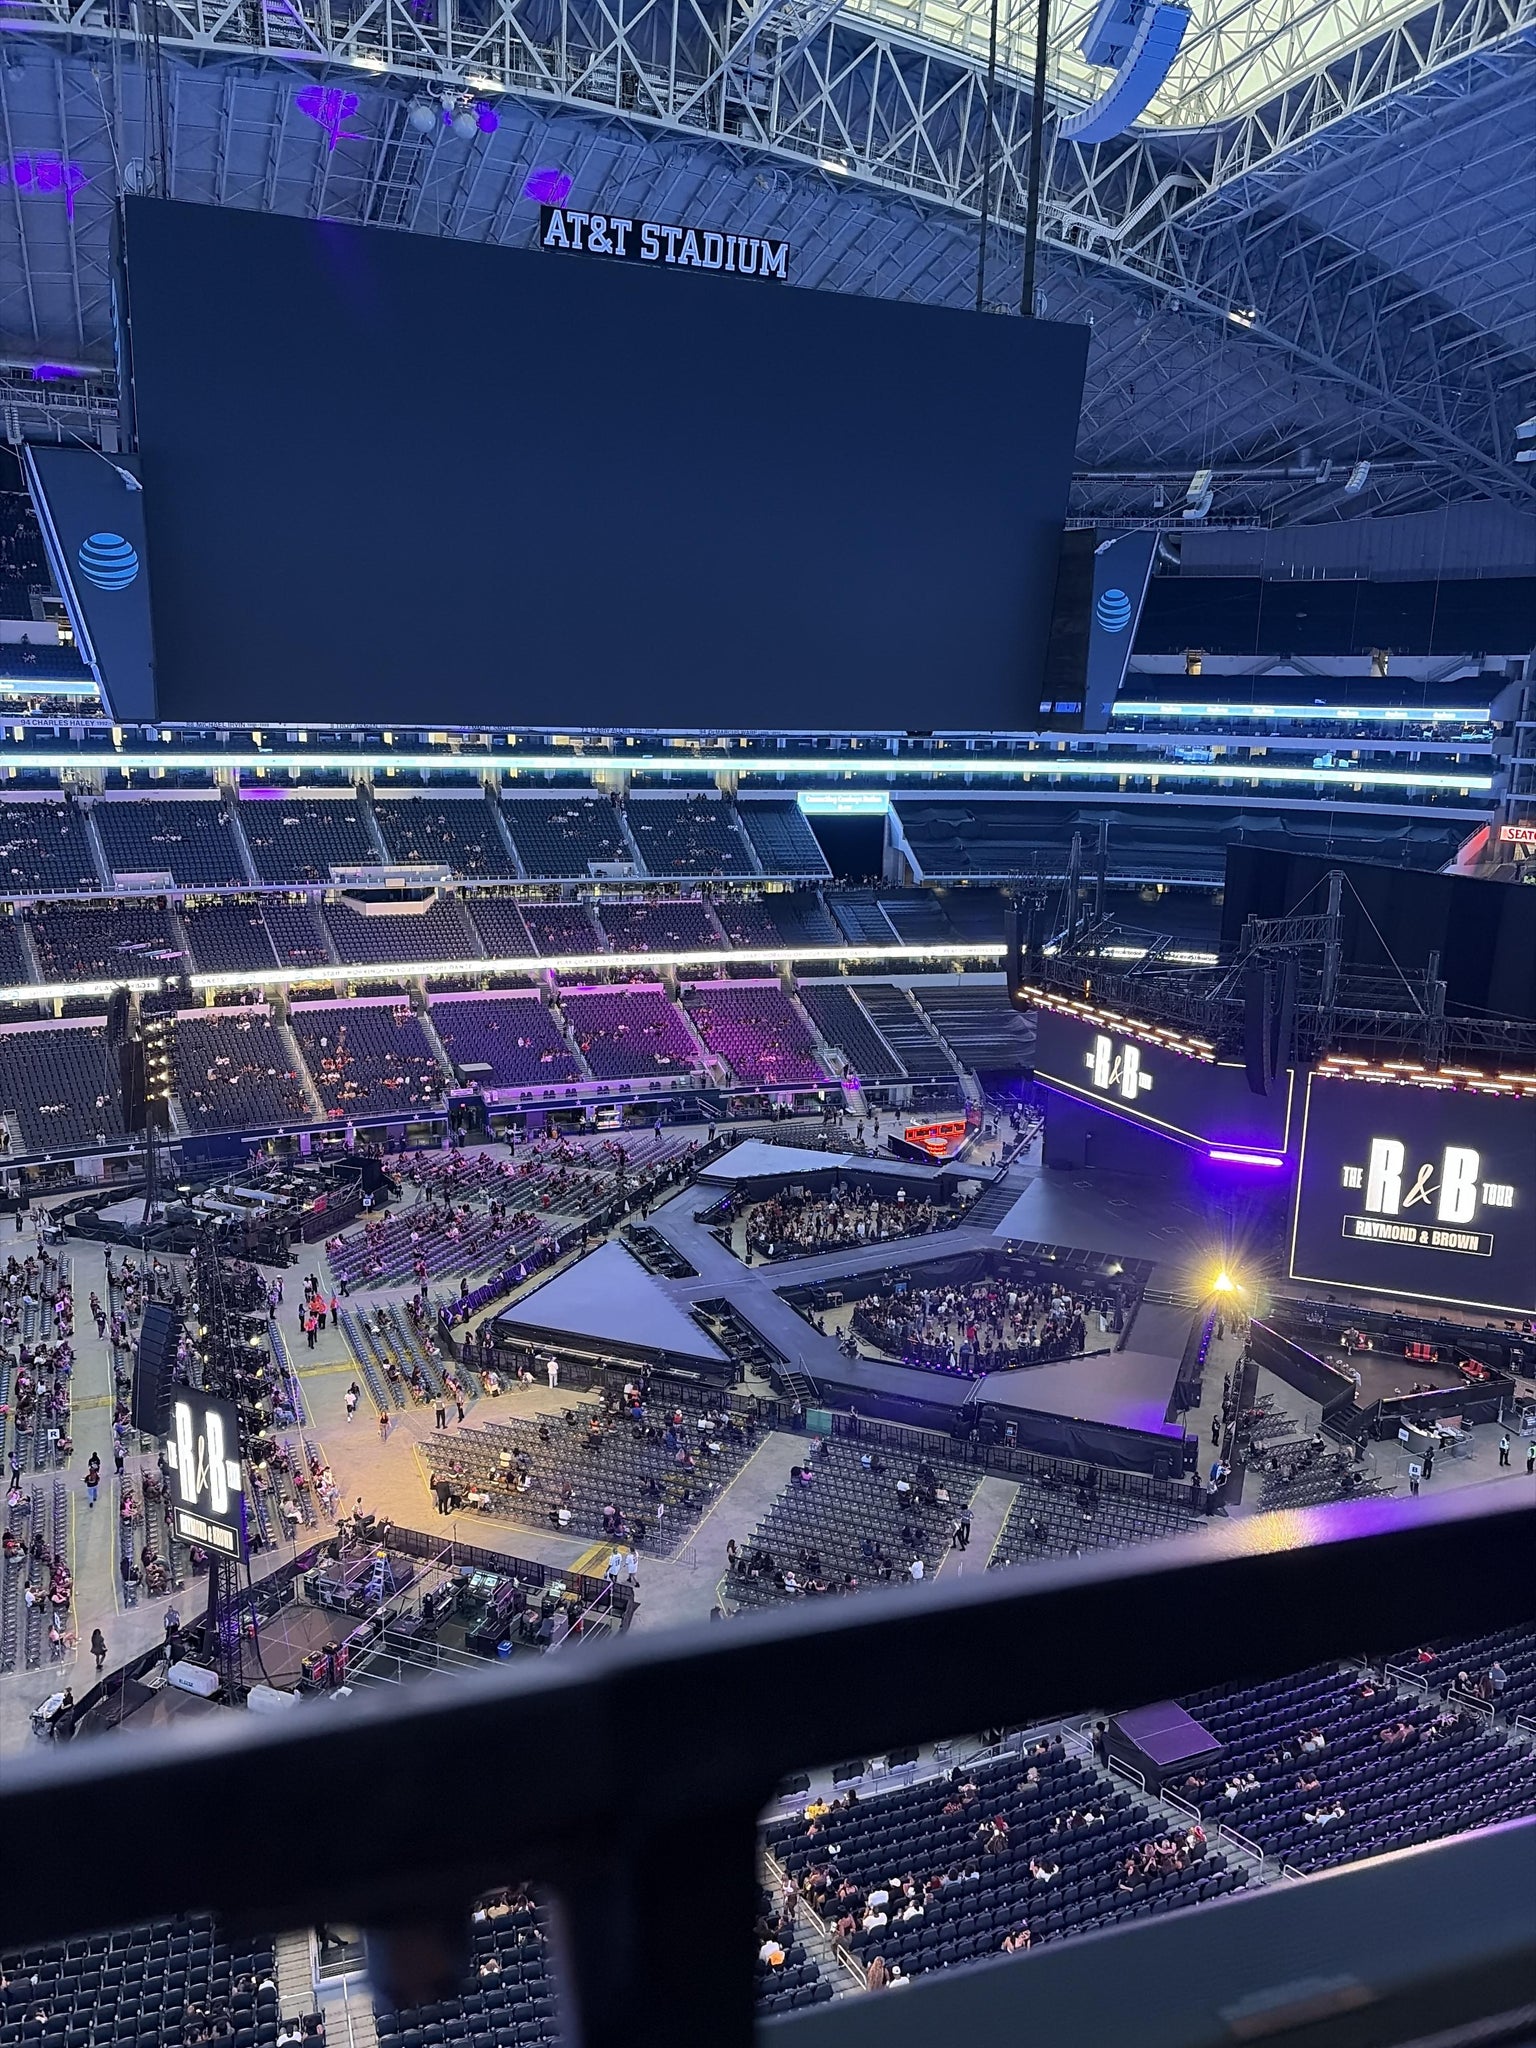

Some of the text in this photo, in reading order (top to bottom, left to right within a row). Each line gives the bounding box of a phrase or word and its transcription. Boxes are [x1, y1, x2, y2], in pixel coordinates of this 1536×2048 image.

[544, 209, 789, 278] AT&T STADIUM
[32, 719, 69, 727] CHARLES
[1508, 829, 1536, 840] SEAT
[1343, 1165, 1364, 1188] THE
[1482, 1182, 1514, 1208] TOUR
[1355, 1220, 1479, 1251] RAYMOND & BROWN
